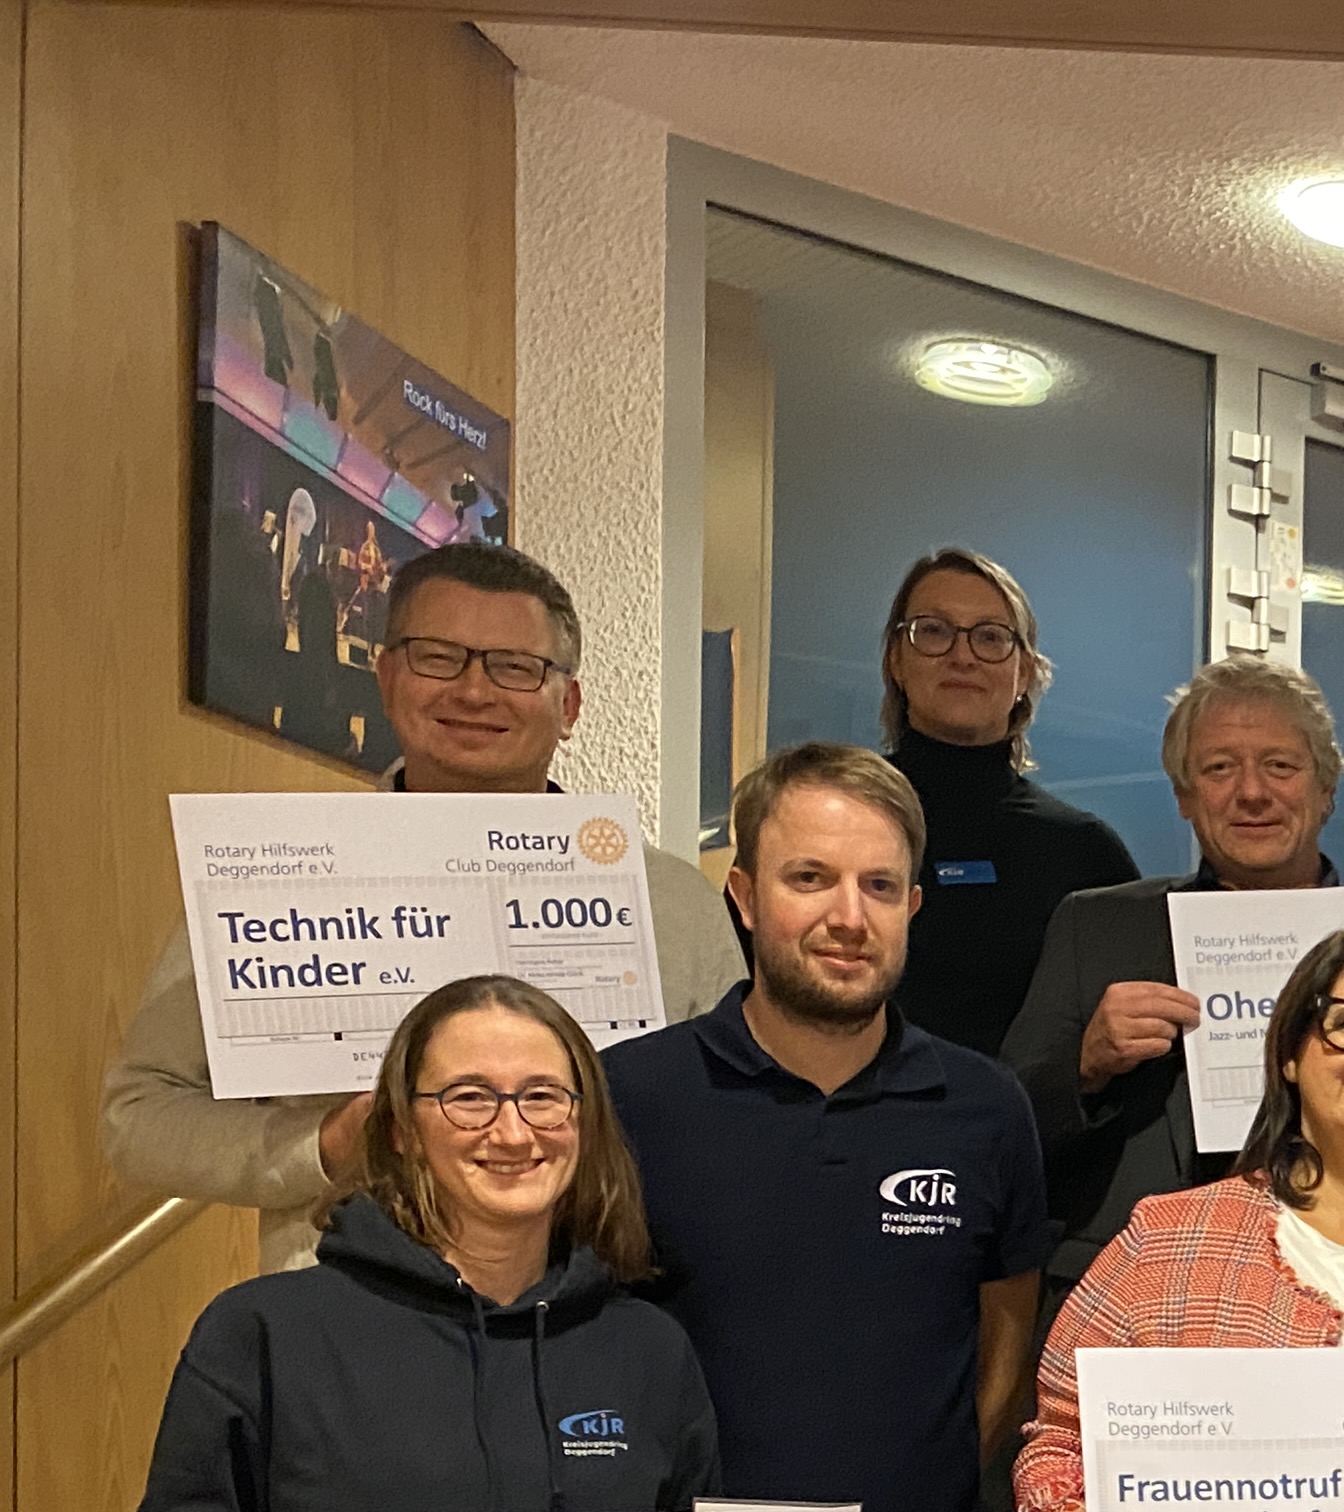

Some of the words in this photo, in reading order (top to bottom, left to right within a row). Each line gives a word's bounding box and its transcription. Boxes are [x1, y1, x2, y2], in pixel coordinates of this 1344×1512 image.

[403, 379, 433, 416] Rock
[204, 844, 256, 860] Rotary
[261, 842, 335, 858] Hilfswerk
[487, 830, 570, 855] Rotary
[207, 860, 303, 880] Deggendorf
[445, 858, 480, 873] Club
[486, 857, 575, 876] Deggendorf
[217, 906, 383, 944] Technik
[391, 905, 451, 939] für
[1194, 934, 1236, 949] Rotary
[1239, 932, 1299, 947] Hilfswerk
[1195, 949, 1272, 966] Deggendorf
[227, 953, 367, 990] Kinder
[378, 966, 415, 986] e.V.
[1206, 990, 1277, 1021] Ohe
[1235, 1028, 1258, 1040] und
[881, 1211, 962, 1228] Kreisjugendring
[881, 1223, 946, 1236] Deggendorf
[1107, 1401, 1156, 1420] Rotary
[1163, 1401, 1234, 1417] Hilfswerk
[1108, 1420, 1202, 1440] Deggendorf
[1118, 1467, 1343, 1502] Frauennotruf
